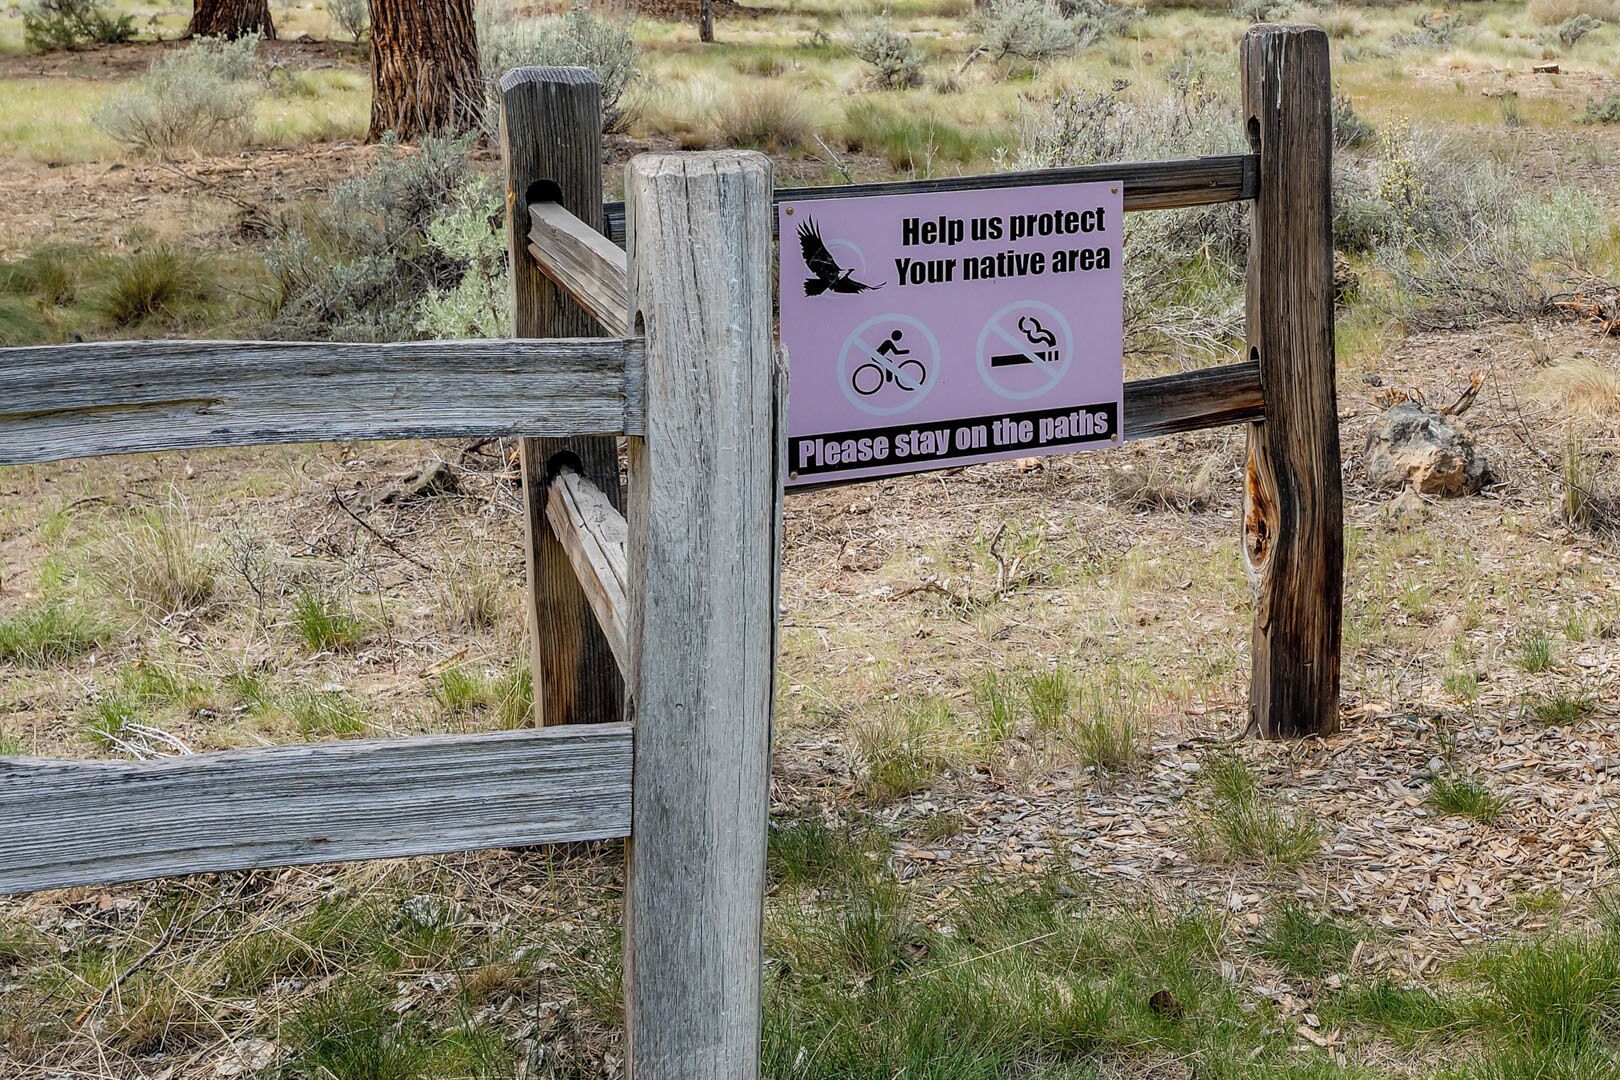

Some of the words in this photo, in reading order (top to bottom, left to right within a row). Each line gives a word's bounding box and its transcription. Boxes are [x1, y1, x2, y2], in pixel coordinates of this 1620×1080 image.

[903, 215, 964, 246] Help
[971, 215, 1003, 241] us
[1010, 206, 1105, 240] protect
[895, 257, 956, 286] Your
[963, 250, 1045, 281] native
[1052, 246, 1110, 273] area
[799, 437, 889, 468] Please
[895, 429, 949, 455] stay
[955, 424, 987, 450] on
[992, 417, 1033, 444] the
[1039, 409, 1108, 443] paths
